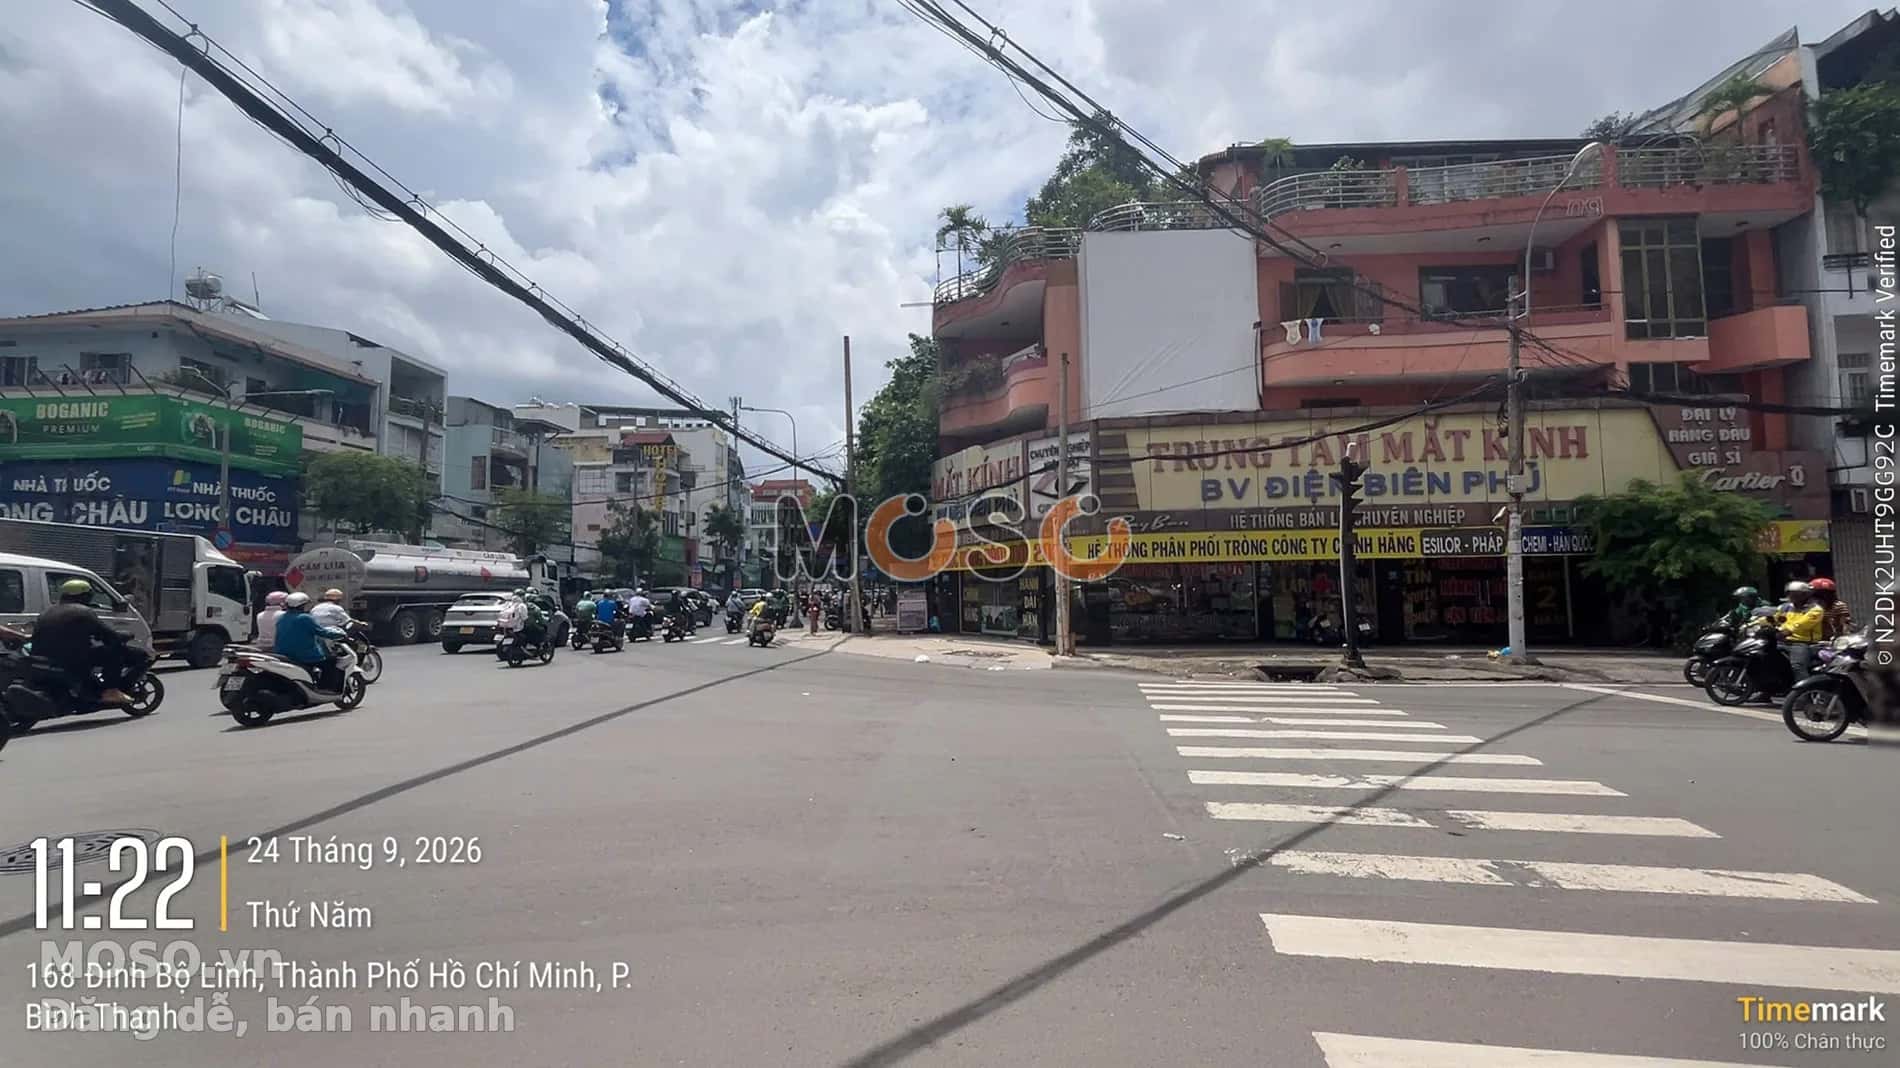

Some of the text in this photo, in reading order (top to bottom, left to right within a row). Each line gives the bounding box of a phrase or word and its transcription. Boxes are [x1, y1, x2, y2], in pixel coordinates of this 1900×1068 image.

[36, 402, 109, 419] BOGANIC
[43, 424, 100, 433] PREMIUM
[244, 418, 285, 434] BOGANIC
[1147, 418, 1588, 472] TRUNG TÂM MẮT KNH
[1688, 447, 1717, 465] GIÁ
[13, 475, 48, 493] NHÀ
[967, 456, 1024, 494] KÍNH
[1201, 478, 1250, 501] BV
[1363, 467, 1450, 497] BIÊN
[1700, 468, 1785, 491] Cartier
[231, 486, 276, 502] THUỐC
[71, 494, 148, 524] CHÂU
[236, 507, 291, 527] CHÂU
[1414, 505, 1465, 528] NGHIỆP
[1151, 536, 1185, 558] PHÂN
[1190, 533, 1219, 556] PHỐI
[1224, 534, 1267, 556] TRÒNG
[1272, 534, 1306, 555] CÔNG
[1311, 537, 1327, 553] TY
[1332, 535, 1373, 554] CNH
[1379, 531, 1415, 553] HÃNG
[1423, 537, 1461, 554] ESILOR
[1473, 532, 1503, 553] PHÁP
[1522, 535, 1547, 553] CHEMI
